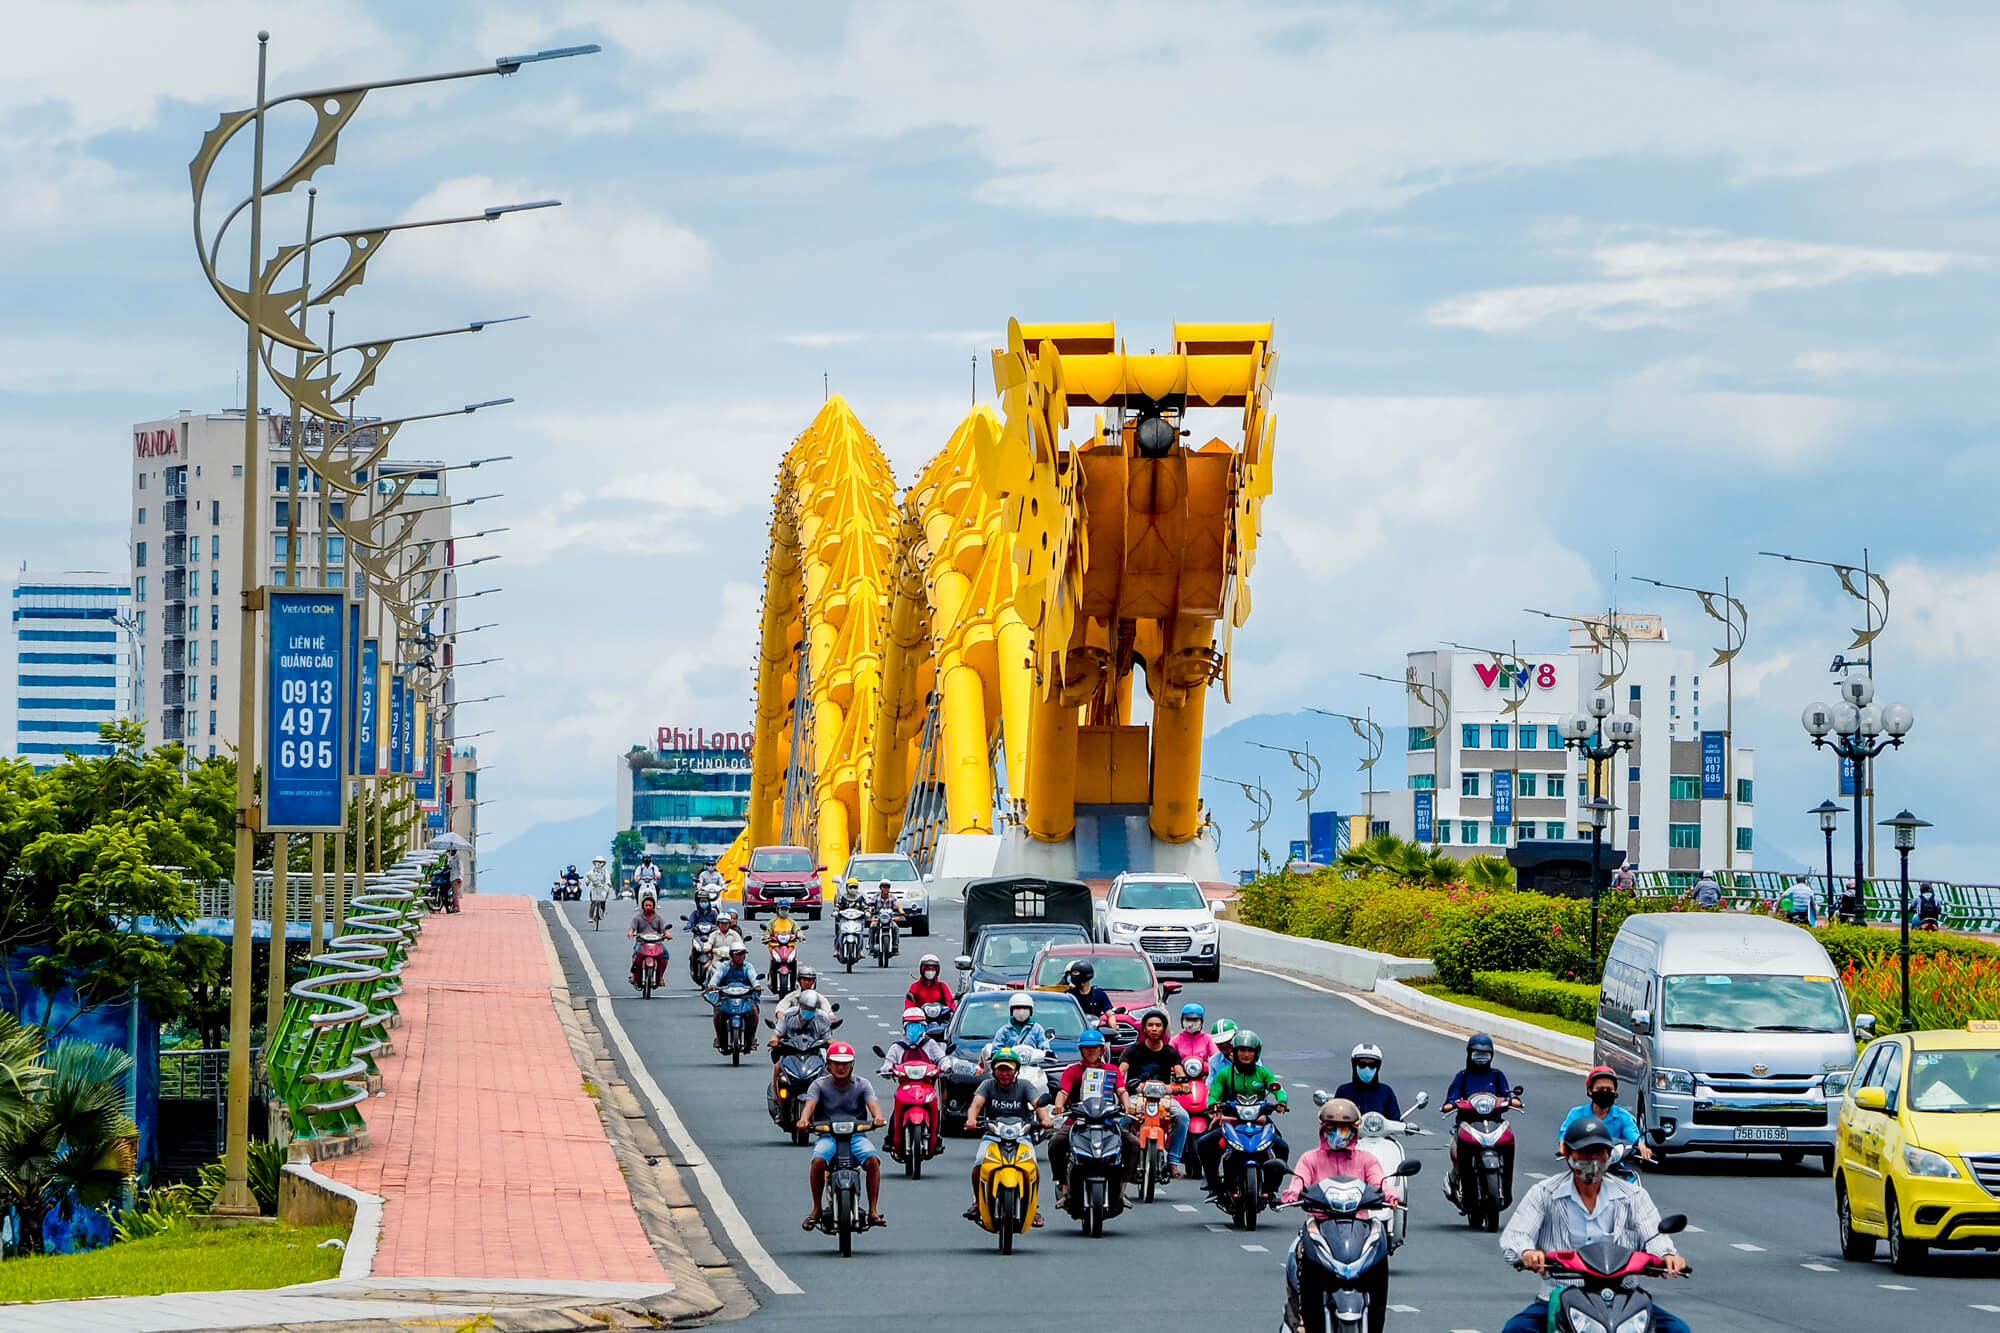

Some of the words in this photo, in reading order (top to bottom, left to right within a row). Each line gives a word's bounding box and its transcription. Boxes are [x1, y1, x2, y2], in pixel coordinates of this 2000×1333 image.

[135, 428, 178, 458] VANDA
[281, 604, 311, 614] VietArt
[289, 634, 311, 650] LIÊN
[312, 634, 326, 652] HỆ
[281, 652, 313, 669] QUẢNG
[314, 653, 334, 669] CÁO
[281, 679, 333, 704] 0913
[280, 707, 332, 736] 497
[657, 727, 755, 757] PhiLong
[281, 740, 332, 769] 695
[1705, 764, 1721, 773] 497
[1705, 773, 1721, 783] 695
